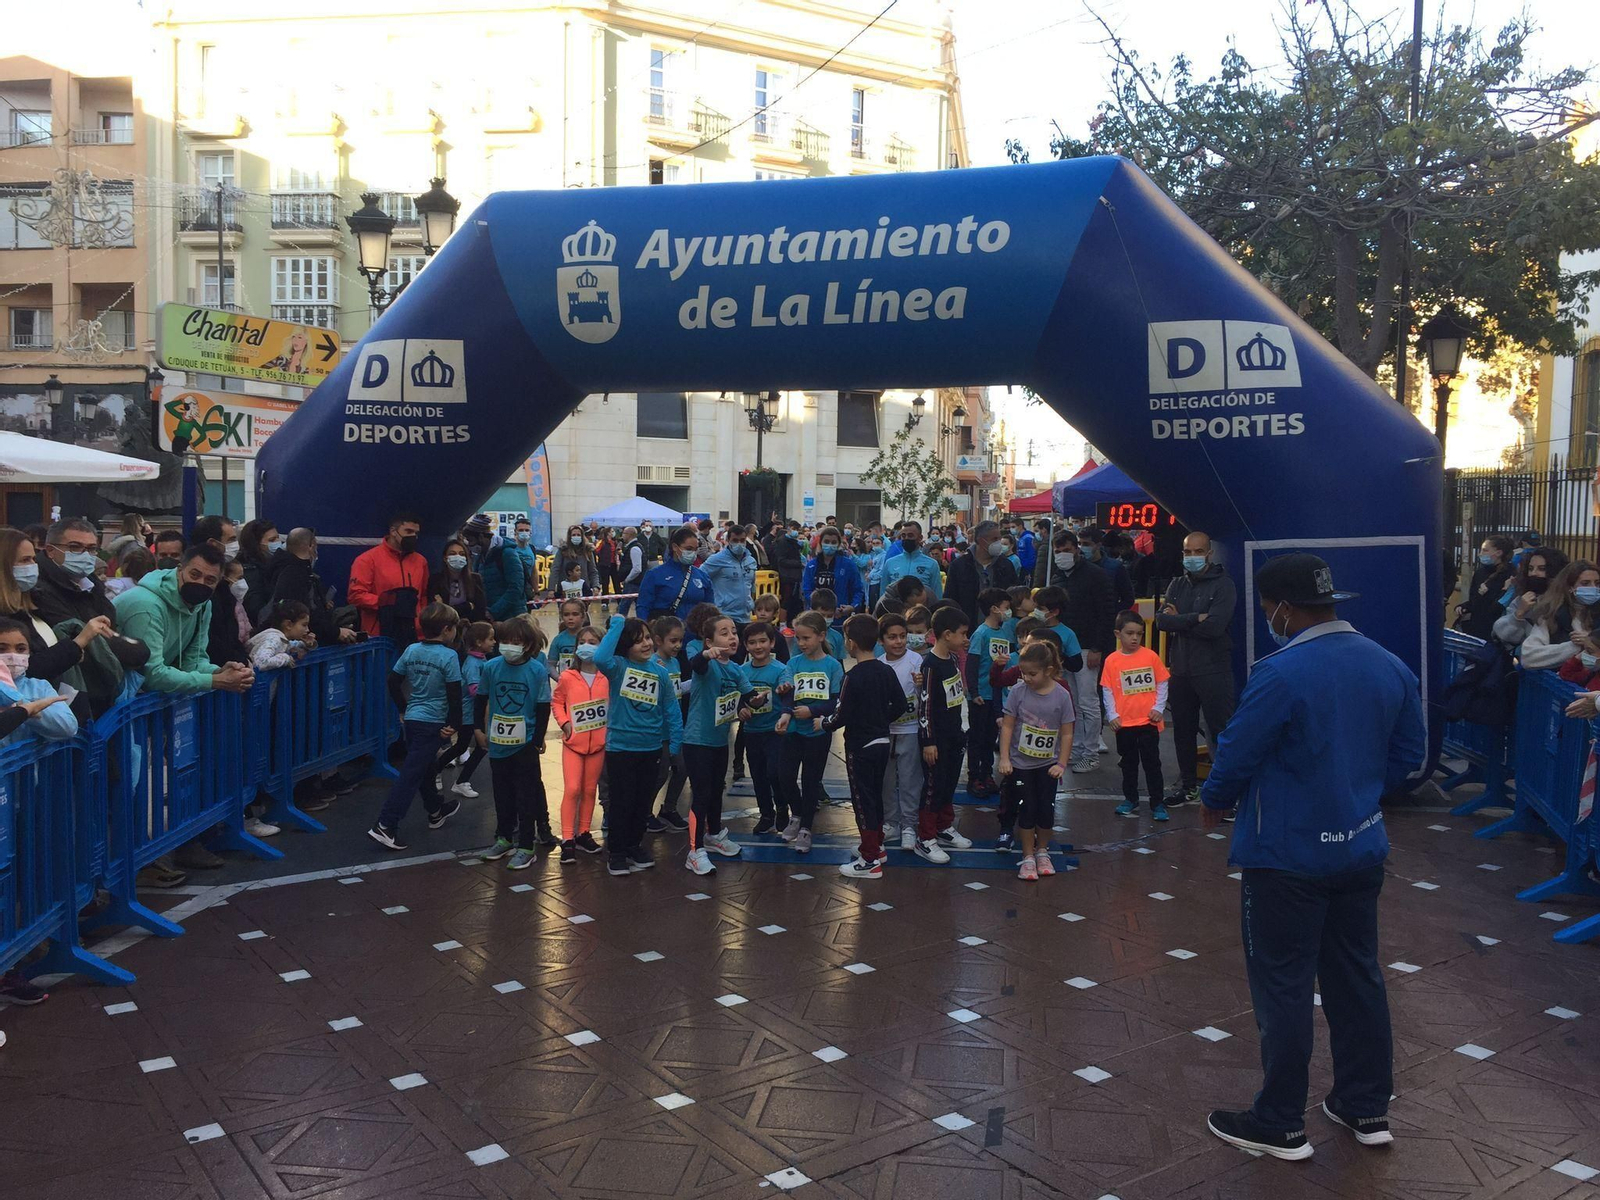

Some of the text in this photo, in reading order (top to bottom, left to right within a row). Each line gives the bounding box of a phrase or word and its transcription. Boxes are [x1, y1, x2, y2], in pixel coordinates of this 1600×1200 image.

[635, 215, 1011, 281] Ayuntamiento
[678, 278, 968, 330] de La Línea
[182, 309, 270, 346] Chantal
[201, 350, 216, 359] VENTA
[217, 352, 223, 360] DE
[1166, 337, 1206, 379] D
[168, 356, 198, 369] C/DUQUE
[200, 361, 208, 370] DE
[266, 370, 277, 379] 956
[361, 354, 389, 389] D
[1150, 391, 1276, 411] DELEGACIÓN DE
[345, 404, 444, 418] DELEGACIÓN DE
[254, 416, 284, 426] Hambu
[1151, 412, 1305, 440] DEPORTES
[343, 422, 471, 444] DEPORTES
[625, 676, 657, 694] 241
[797, 678, 826, 691] 216
[1124, 673, 1153, 686] 146
[574, 705, 606, 723] 296
[718, 699, 736, 716] 348
[497, 722, 517, 736] 67
[1025, 733, 1054, 749] 168
[1320, 831, 1345, 842] Club
